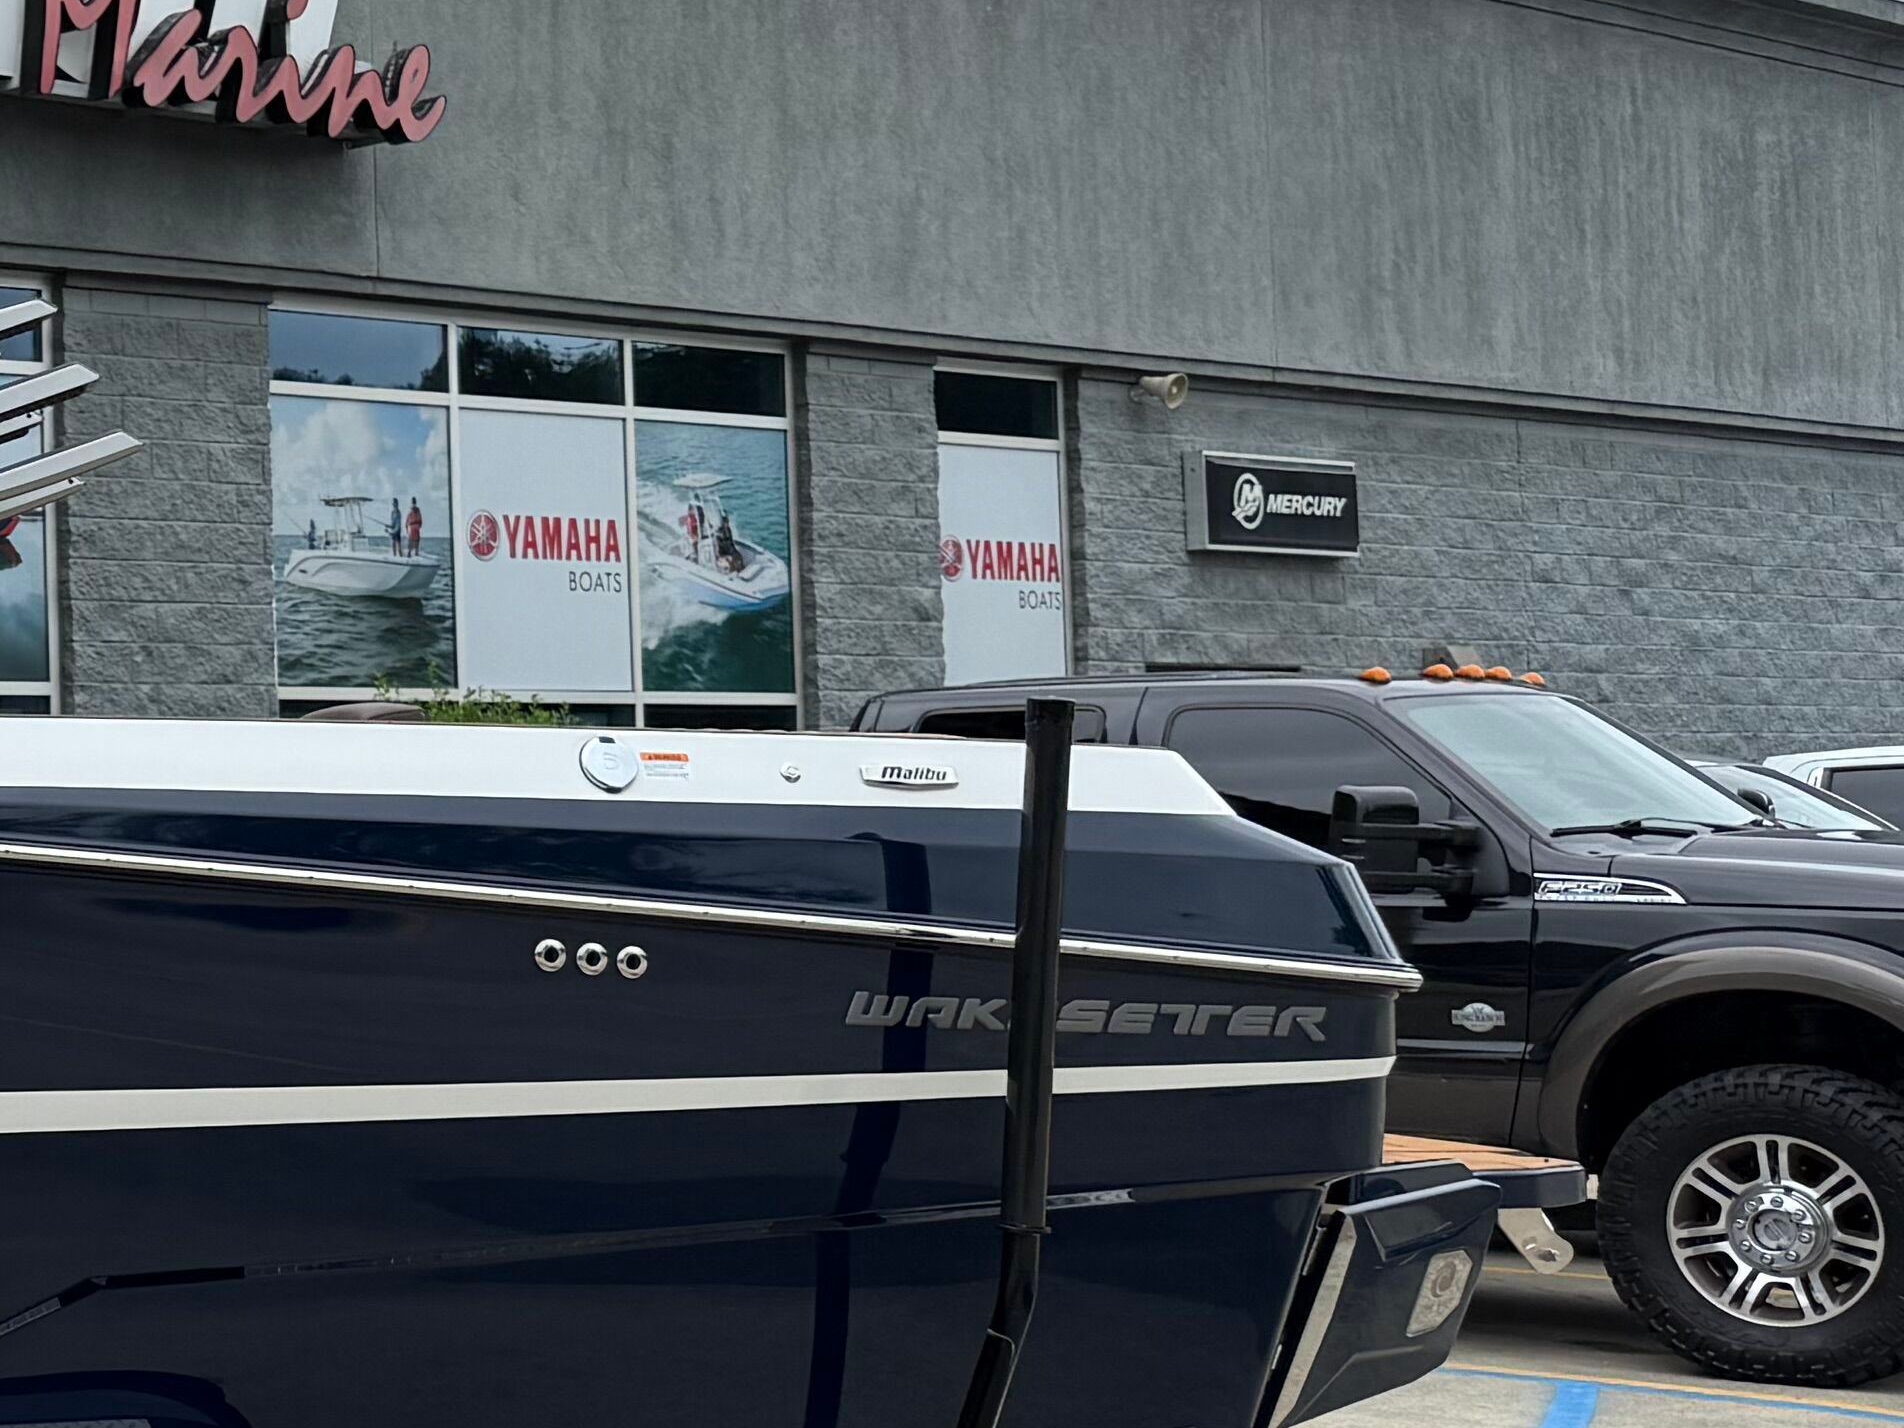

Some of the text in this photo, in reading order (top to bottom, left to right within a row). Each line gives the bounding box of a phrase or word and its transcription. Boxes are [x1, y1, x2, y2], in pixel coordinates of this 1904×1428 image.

[1266, 493, 1347, 517] MERCURY
[502, 514, 622, 563] YAMAHA
[965, 538, 1061, 583] YAMAHA
[568, 570, 622, 593] BOATS
[1018, 590, 1061, 610] BOATS
[880, 766, 948, 782] Malibu
[845, 990, 1327, 1042] WAKSETTER
